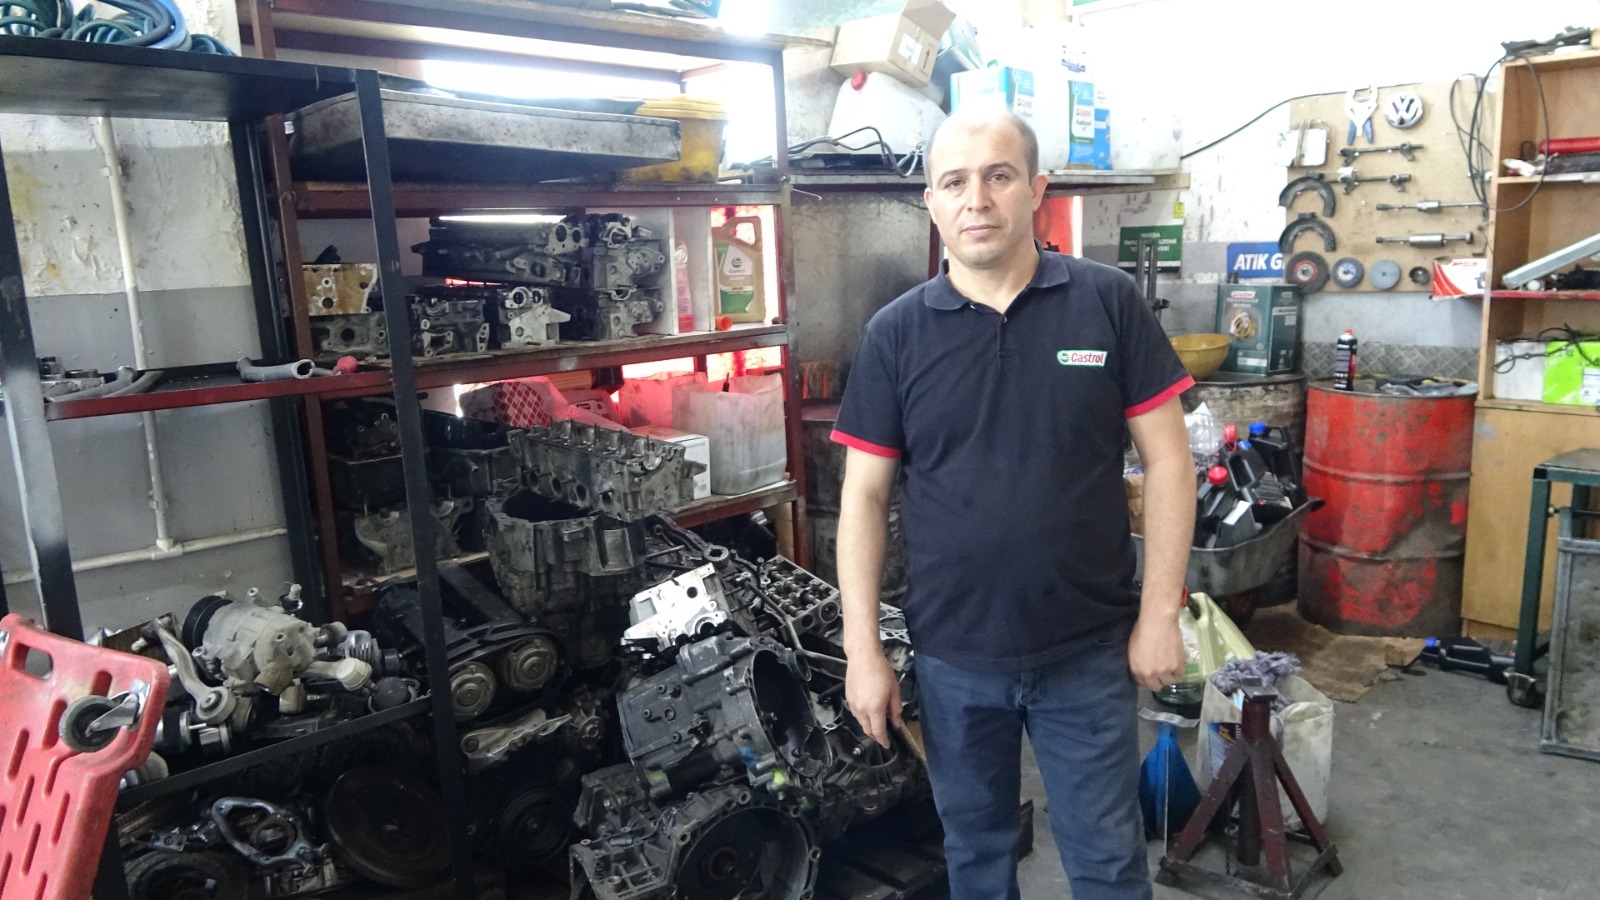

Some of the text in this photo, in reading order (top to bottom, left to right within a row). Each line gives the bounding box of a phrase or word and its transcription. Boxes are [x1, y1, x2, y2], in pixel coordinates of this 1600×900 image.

[1233, 253, 1285, 270] ATIK G
[1071, 352, 1104, 364] Castrol
